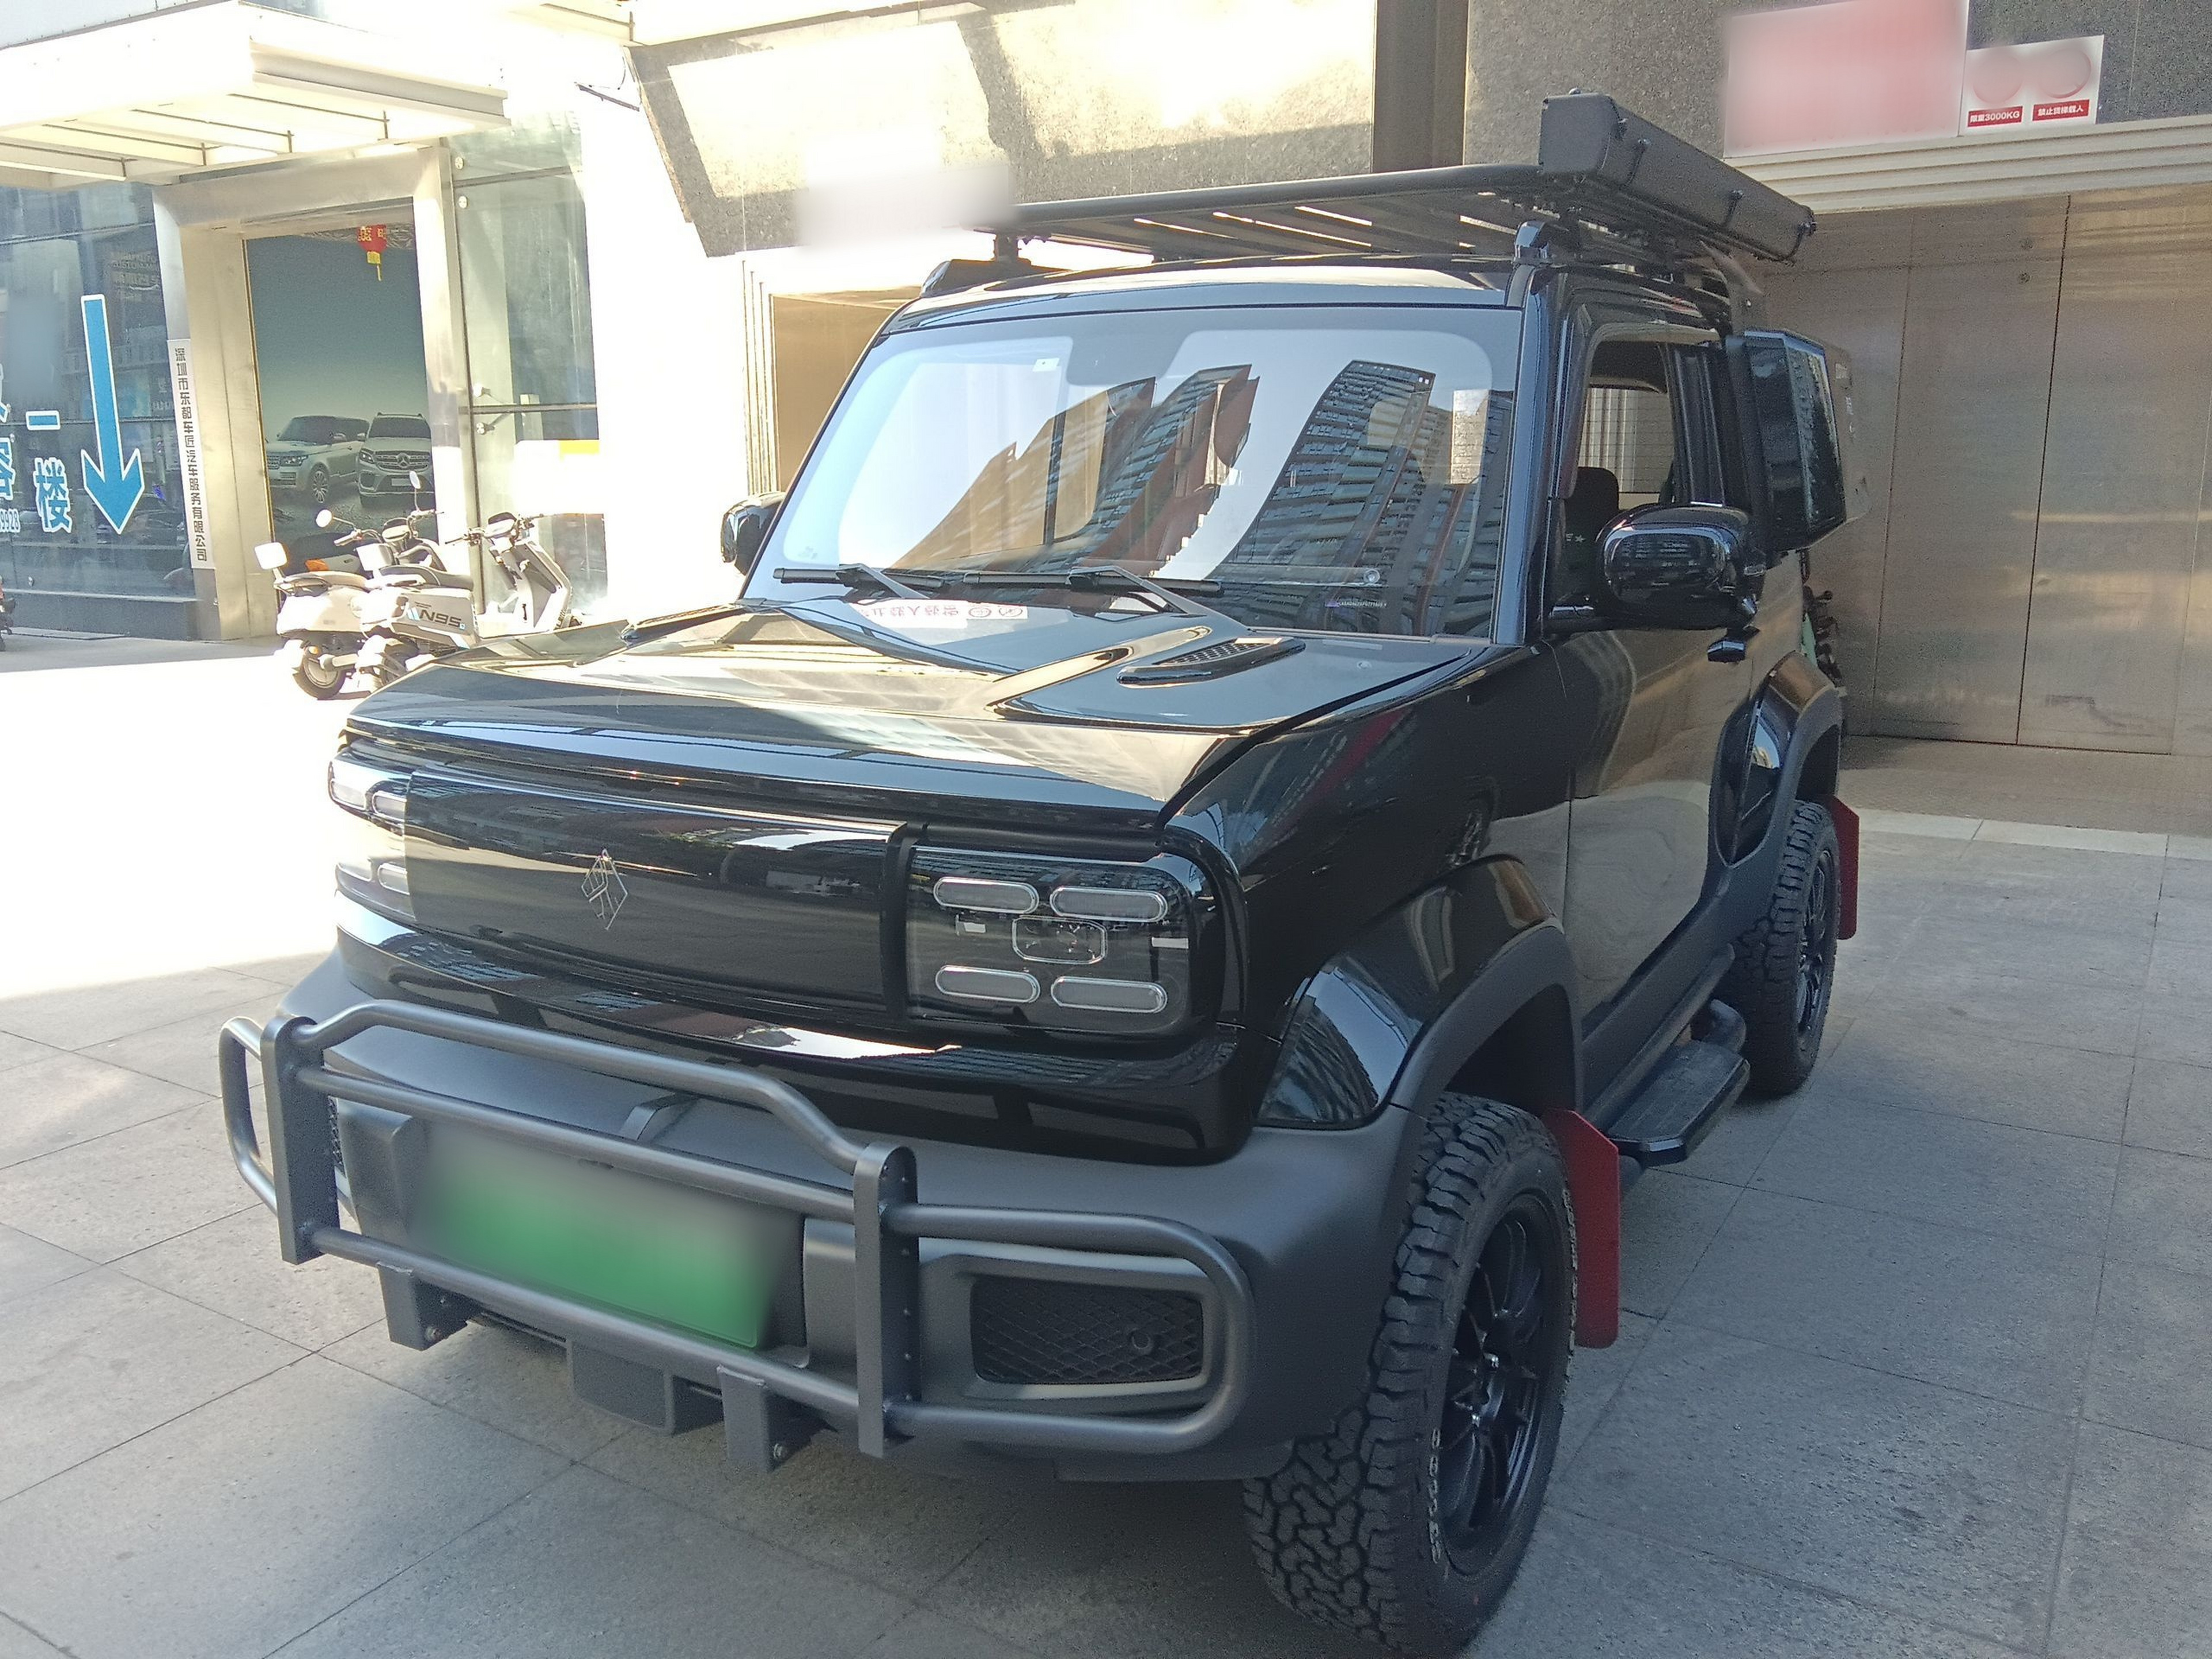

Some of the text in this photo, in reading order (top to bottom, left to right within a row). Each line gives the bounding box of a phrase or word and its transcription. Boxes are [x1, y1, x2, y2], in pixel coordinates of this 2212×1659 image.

[175, 347, 207, 561] 深圳市东都车匠汽车服务有限公司
[0, 508, 20, 533] 9928
